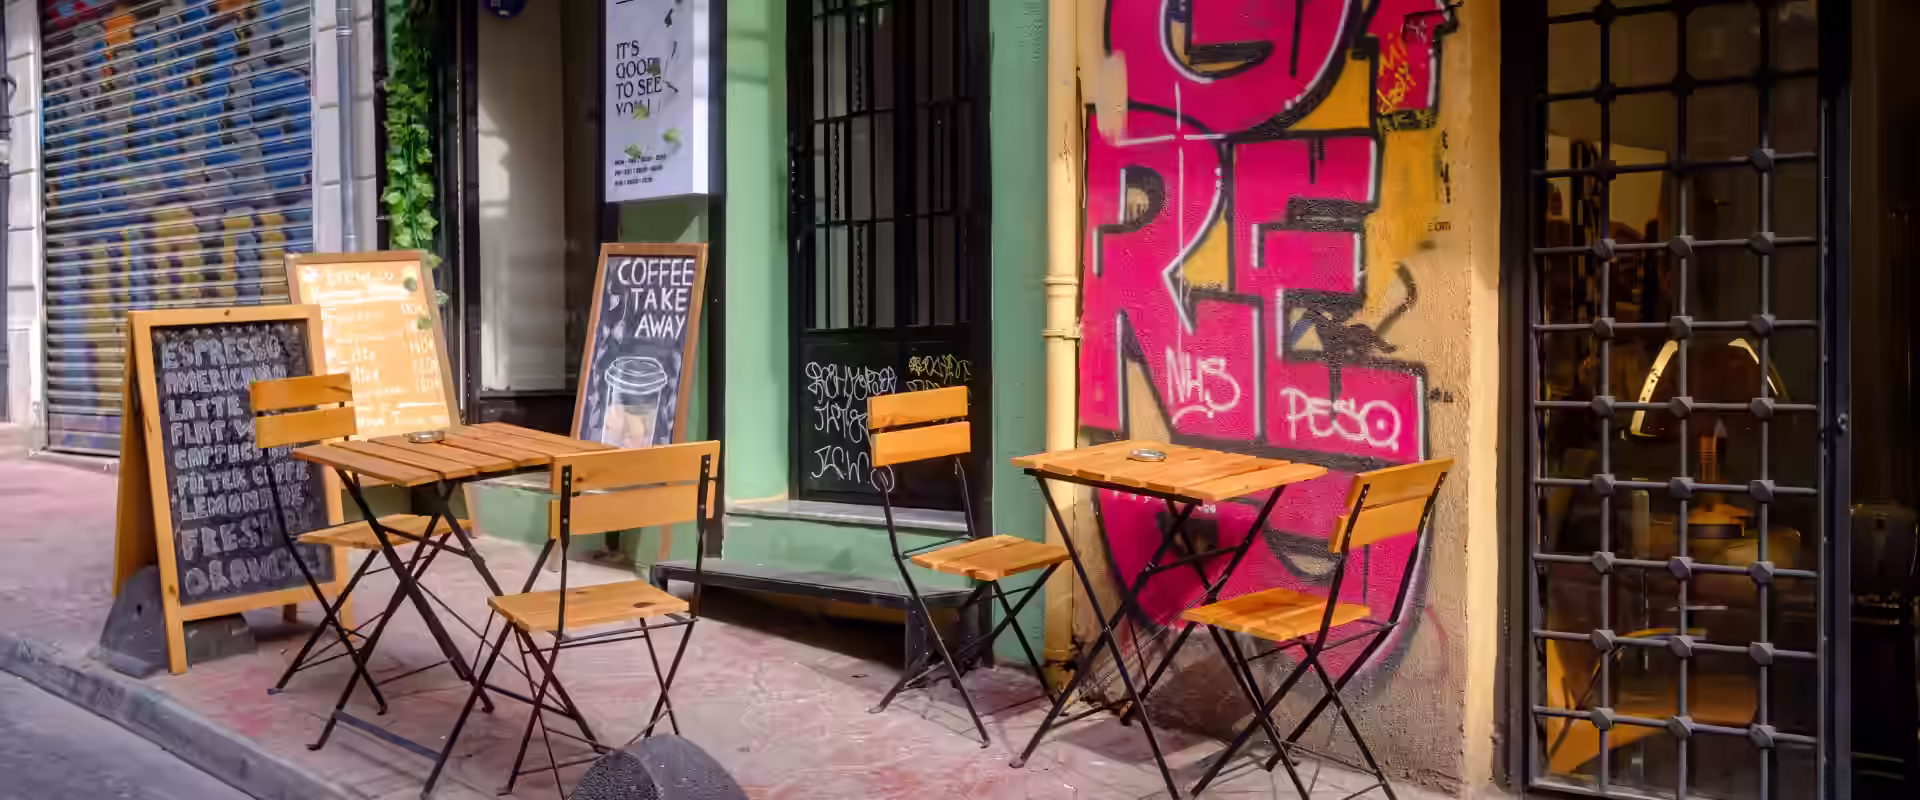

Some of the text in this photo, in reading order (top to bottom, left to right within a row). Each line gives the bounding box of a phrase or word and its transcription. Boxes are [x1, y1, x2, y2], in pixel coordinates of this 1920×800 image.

[616, 40, 640, 60] IT'S
[616, 76, 662, 100] TO SEE
[617, 258, 695, 285] COFFEE
[630, 287, 688, 312] TAKE
[634, 314, 686, 340] AWAY
[161, 335, 281, 369] ESPRESSO
[168, 395, 243, 422] LATTE
[170, 420, 226, 447] FLAT
